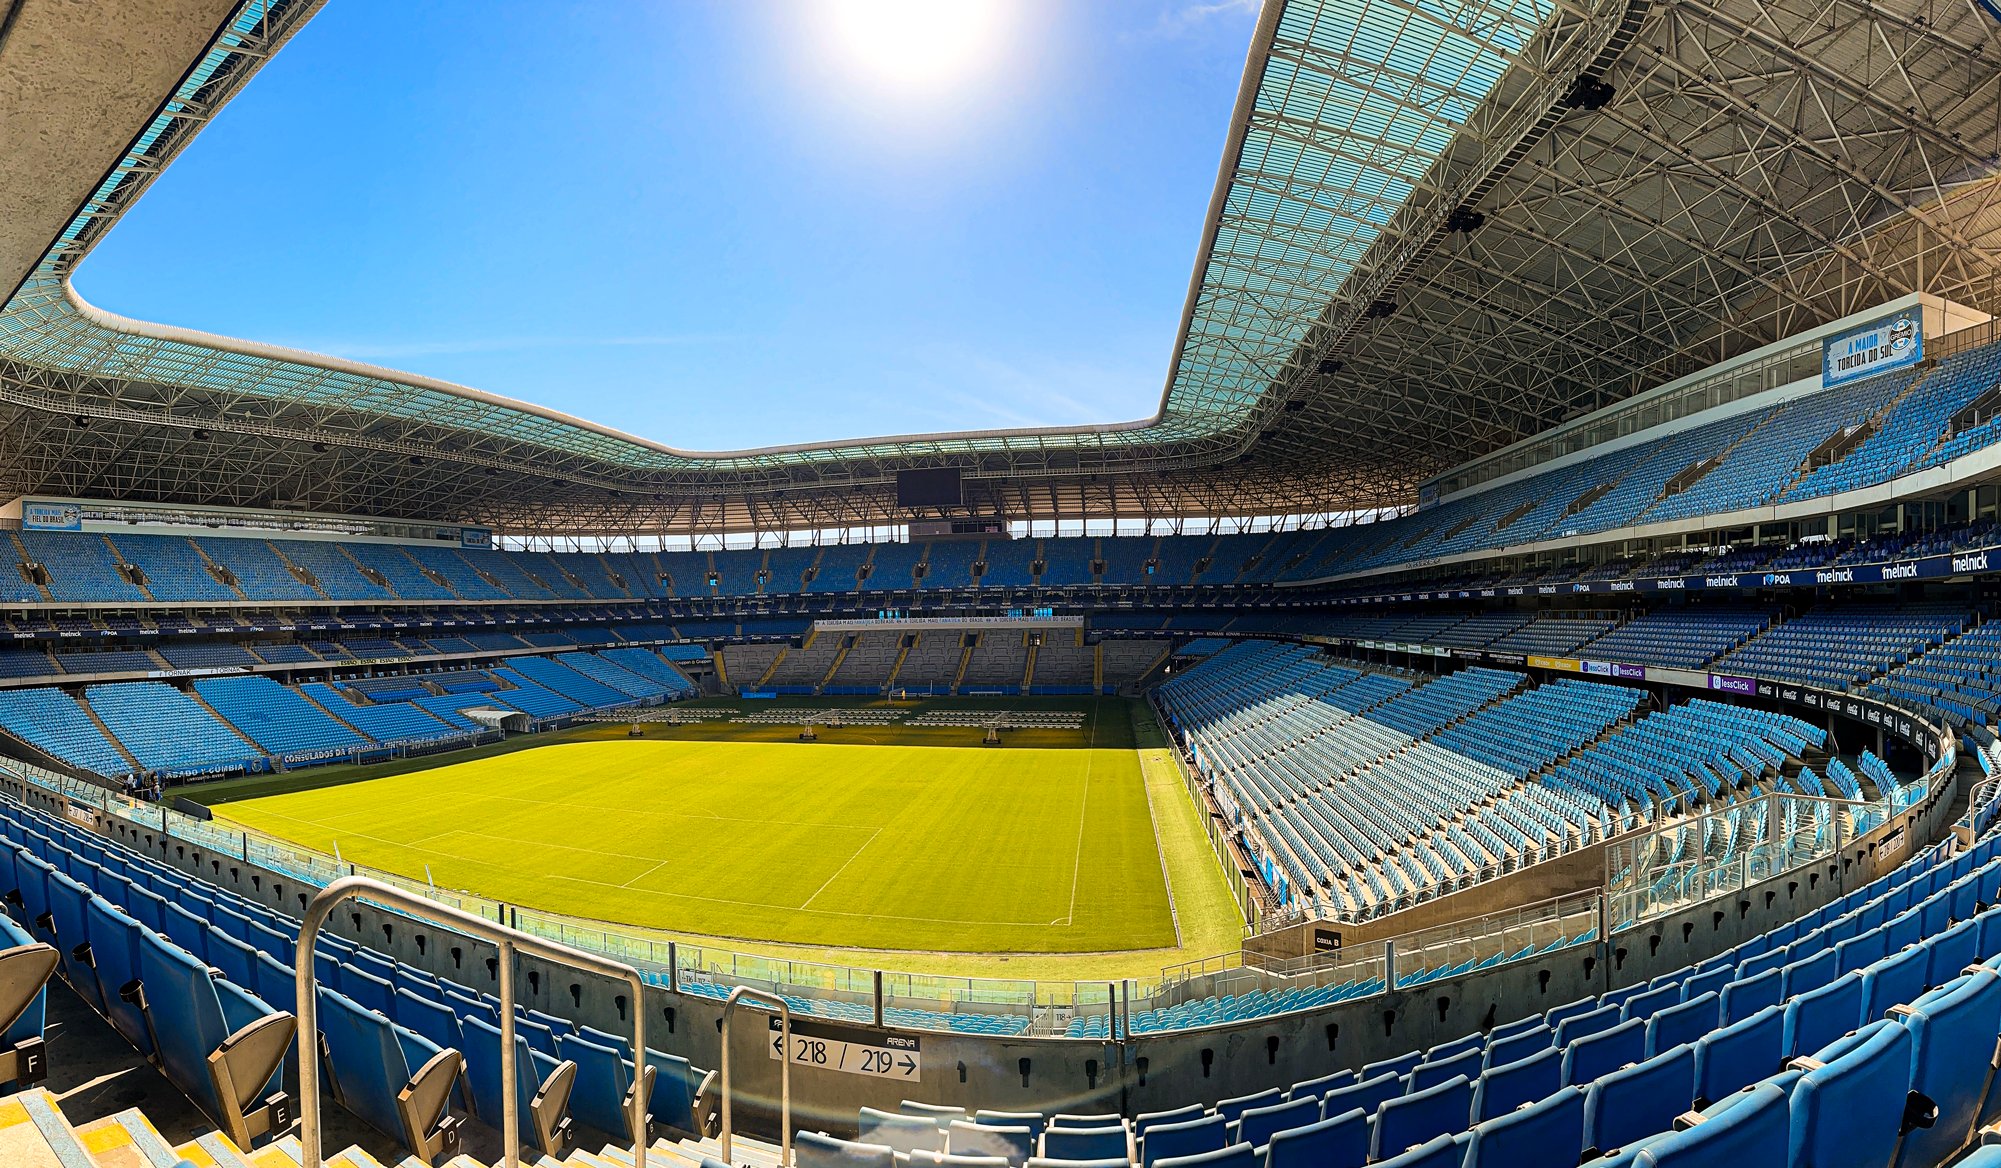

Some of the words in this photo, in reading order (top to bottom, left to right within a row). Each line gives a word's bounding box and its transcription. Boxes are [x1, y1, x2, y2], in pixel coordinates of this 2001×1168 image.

[1848, 342, 1853, 355] A
[1856, 334, 1878, 352] MAIOR
[1837, 354, 1866, 372] TORCIDA
[1868, 348, 1878, 363] DO
[1880, 343, 1894, 359] SUL
[1952, 552, 1988, 572] melnick
[1816, 568, 1853, 583] melnick
[1882, 562, 1918, 580] melnick
[1611, 580, 1634, 590] melnick
[1658, 578, 1685, 589] melnick
[1706, 575, 1738, 587] melnick
[1775, 575, 1790, 585] POA
[1508, 587, 1523, 595] melnick
[1539, 585, 1556, 593] melnick
[1589, 664, 1609, 673] lessClick
[1620, 666, 1642, 677] lessClick
[1721, 679, 1749, 691] lessClick
[284, 750, 334, 763] CONSULADOS
[887, 1037, 915, 1048] ARENA
[796, 1039, 827, 1064] 218
[861, 1049, 893, 1074] 219
[28, 1055, 38, 1073] F
[277, 1108, 286, 1123] E
[448, 1130, 455, 1144] D
